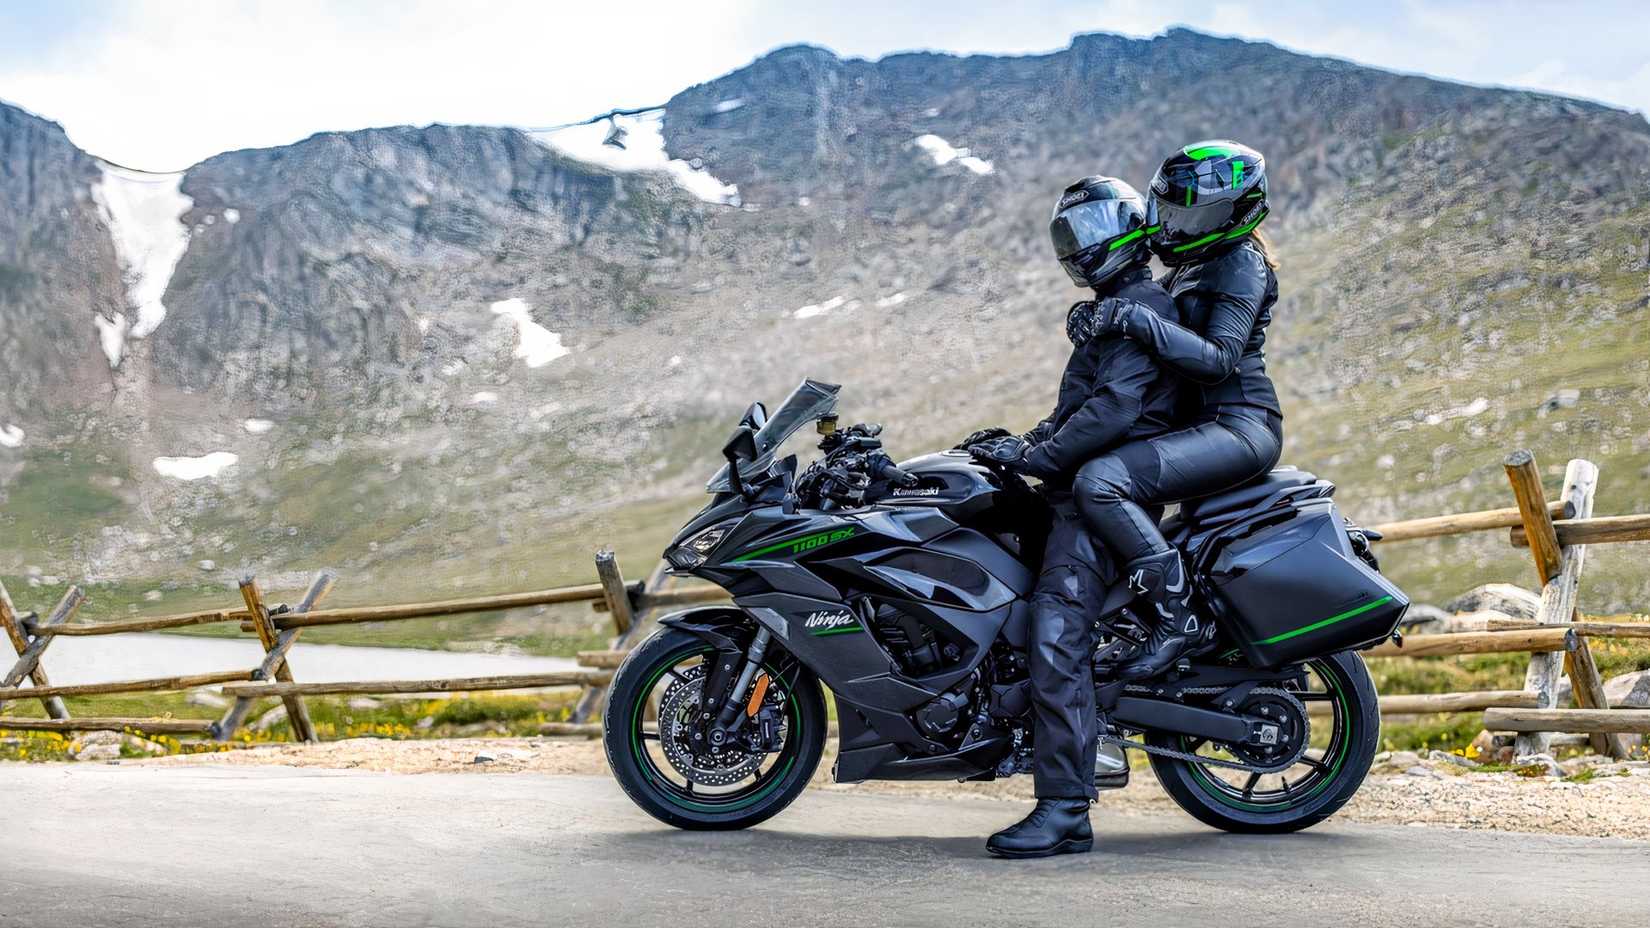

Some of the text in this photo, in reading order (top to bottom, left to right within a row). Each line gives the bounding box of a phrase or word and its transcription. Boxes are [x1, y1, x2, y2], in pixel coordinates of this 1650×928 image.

[893, 486, 940, 496] Kawasaki
[793, 527, 855, 553] 1100 SX
[805, 610, 854, 630] Ninja
